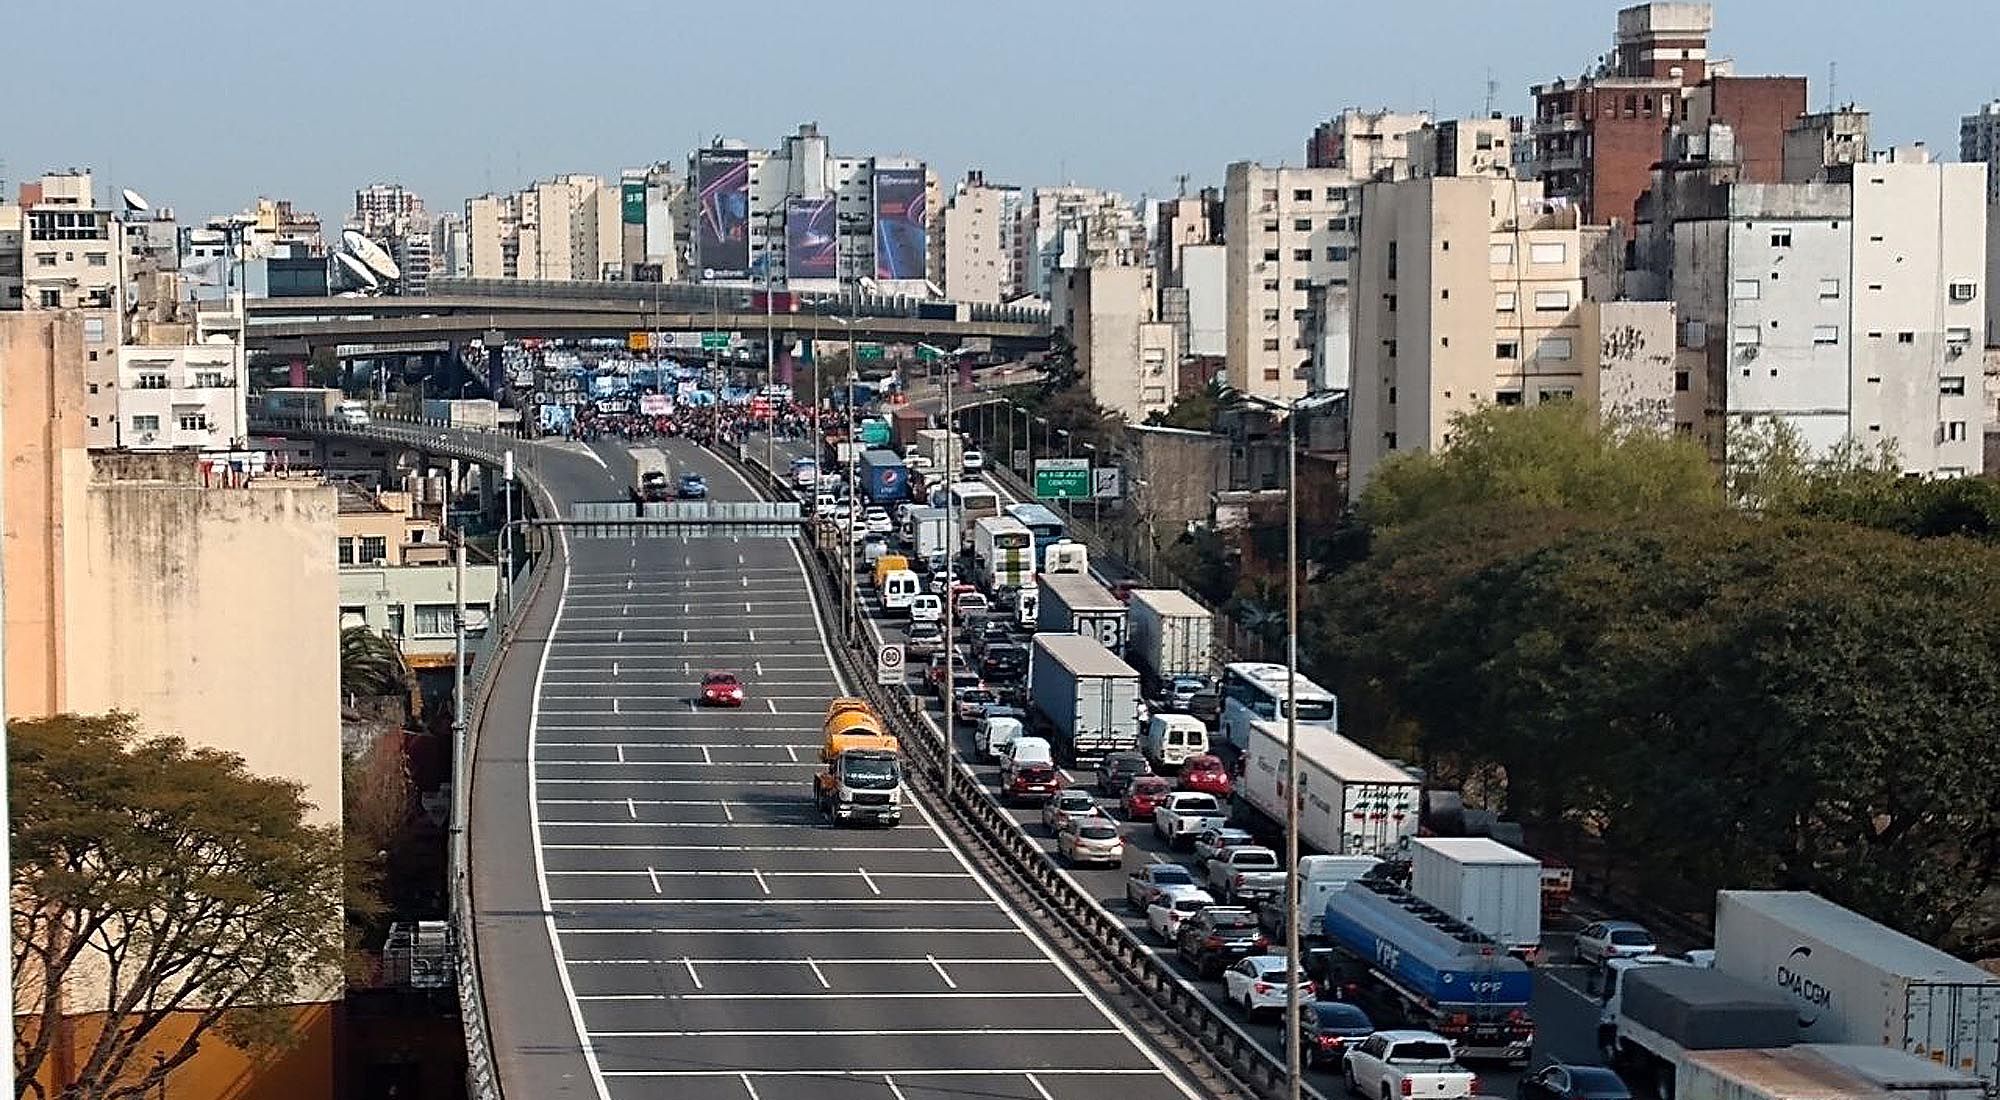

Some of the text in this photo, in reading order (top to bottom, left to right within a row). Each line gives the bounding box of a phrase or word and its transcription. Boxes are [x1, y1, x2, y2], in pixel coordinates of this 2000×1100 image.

[1375, 936, 1400, 969] YPF
[1469, 981, 1503, 993] YPF
[1776, 966, 1831, 1009] CMA CGM
